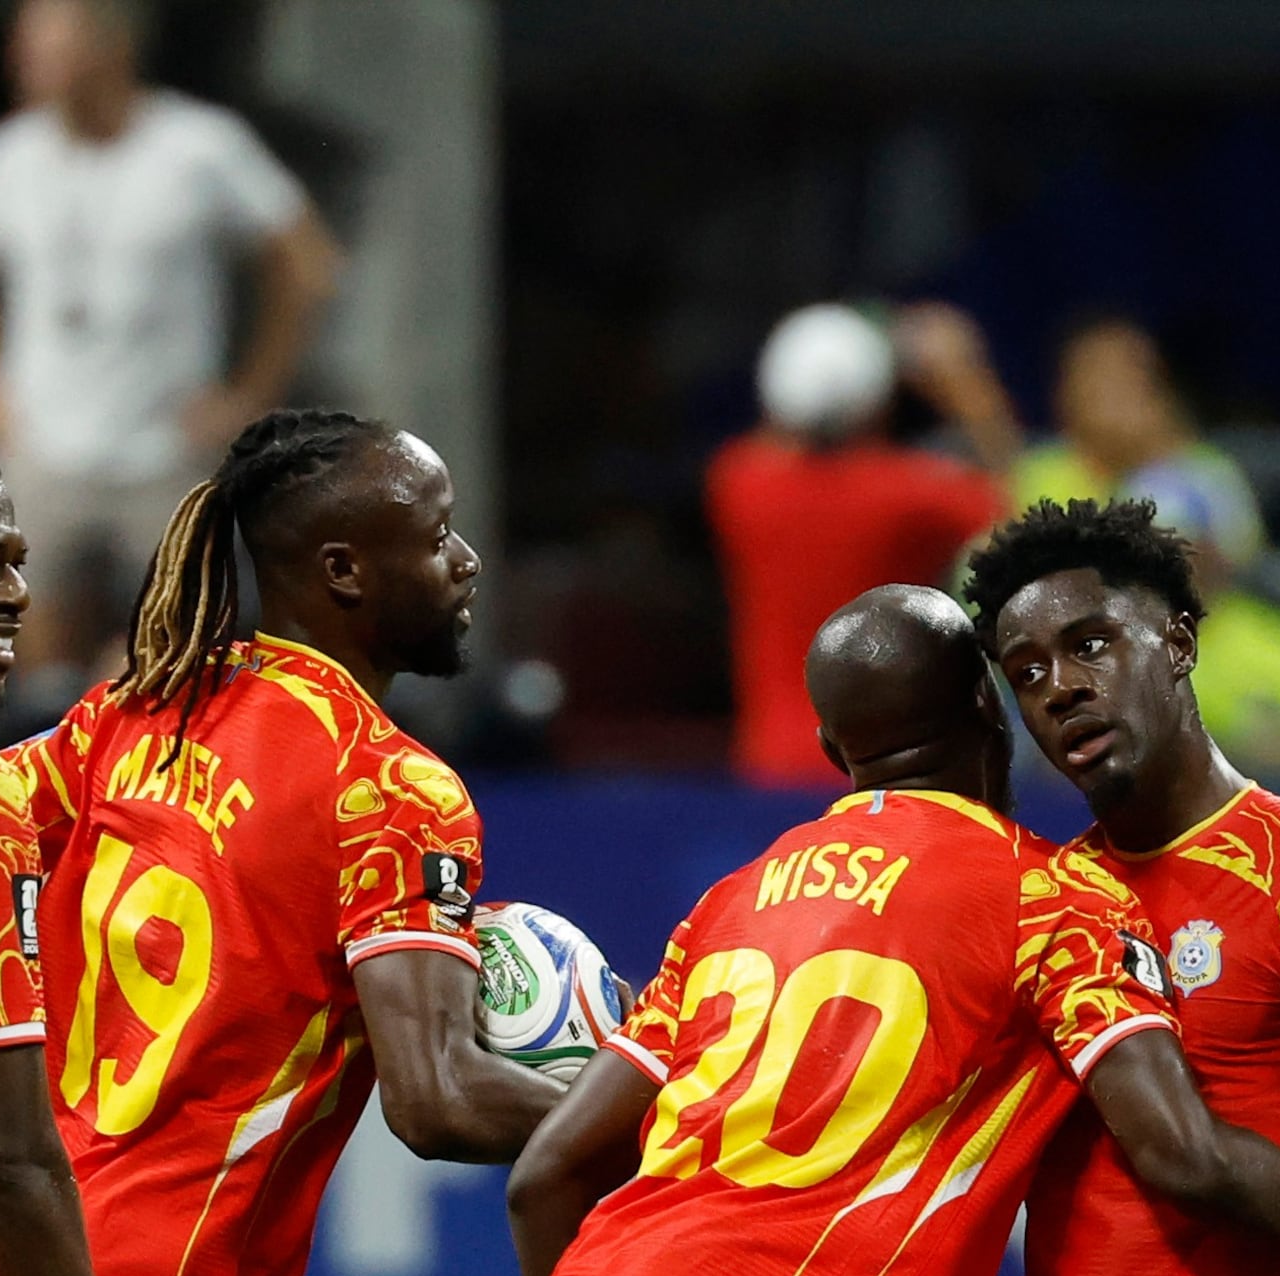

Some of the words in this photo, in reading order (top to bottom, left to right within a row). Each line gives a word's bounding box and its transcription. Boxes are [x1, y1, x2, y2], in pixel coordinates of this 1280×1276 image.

[754, 842, 910, 916] WISSA
[59, 832, 213, 1137] 19
[488, 933, 529, 993] TRIONDA
[637, 947, 929, 1189] 20
